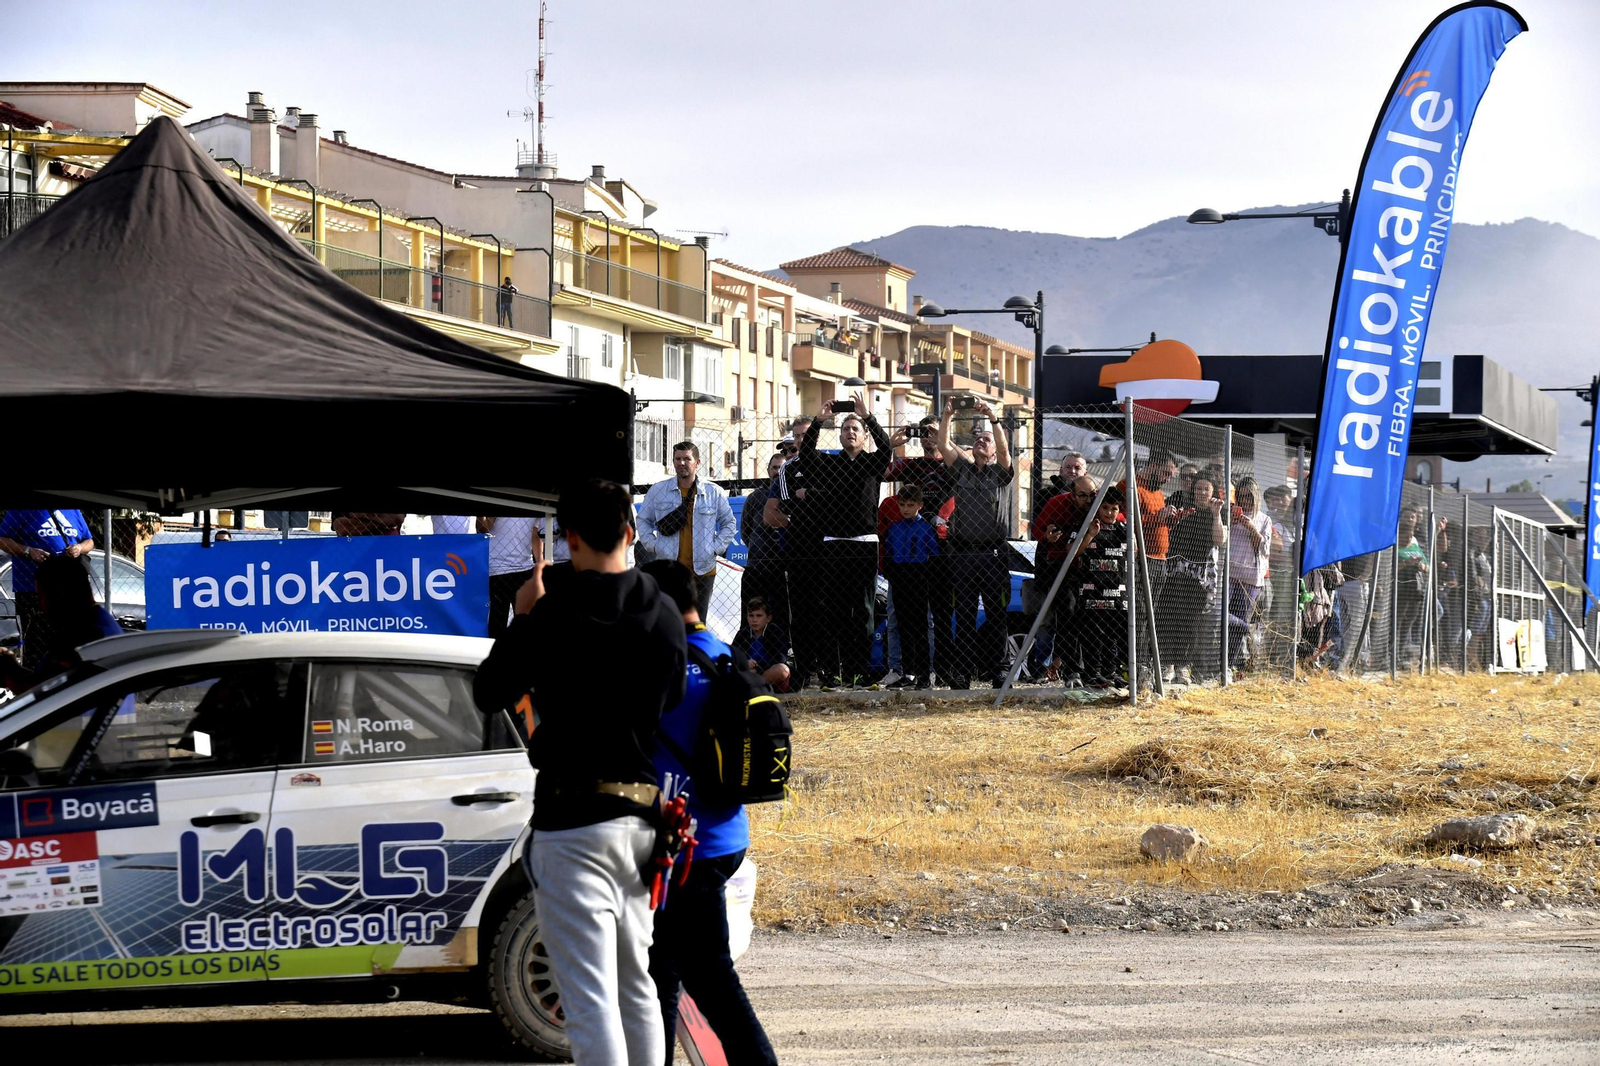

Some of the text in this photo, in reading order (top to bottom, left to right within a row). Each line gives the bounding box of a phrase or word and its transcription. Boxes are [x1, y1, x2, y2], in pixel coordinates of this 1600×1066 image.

[1332, 90, 1454, 479] radiokable
[1400, 284, 1432, 366] MÓVIL.
[1388, 379, 1413, 457] FIBRA.
[172, 557, 457, 609] radiokable
[261, 617, 319, 633] MÓVIL.
[328, 616, 428, 631] PRINCIPIOS.
[336, 717, 414, 734] N.Roma
[339, 738, 407, 755] A.Haro
[741, 737, 752, 787] NIKONISTAS
[14, 839, 61, 859] ASC
[32, 965, 89, 984] SALE
[93, 960, 172, 980] TODOS
[180, 957, 222, 976] LOS
[229, 954, 280, 973] DIAS
